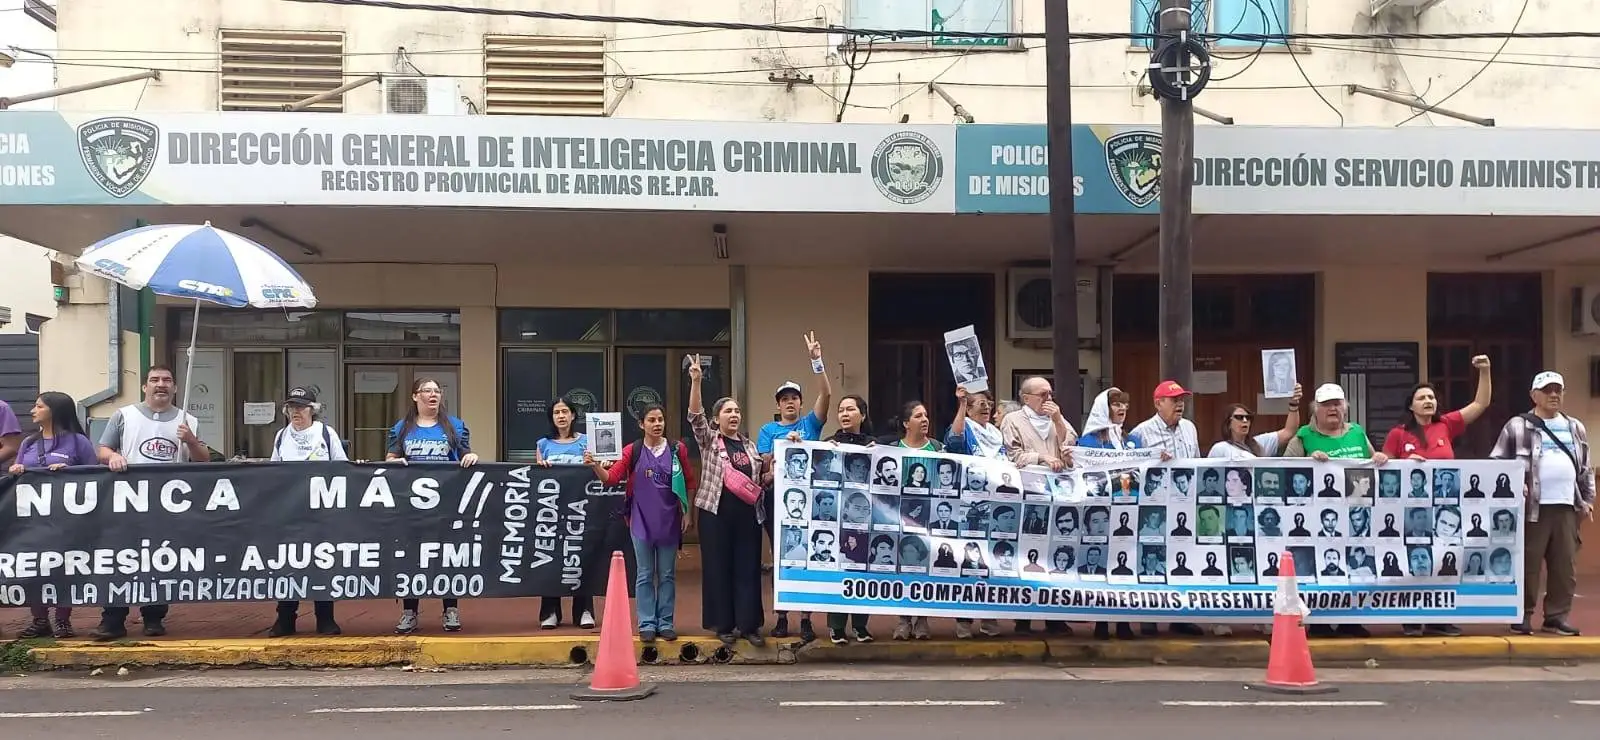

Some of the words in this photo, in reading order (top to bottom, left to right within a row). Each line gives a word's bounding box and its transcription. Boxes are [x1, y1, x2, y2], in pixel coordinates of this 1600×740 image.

[83, 122, 109, 136] POLICIA
[123, 122, 154, 136] MISIONES
[1109, 136, 1133, 149] POLICIA
[1145, 136, 1161, 144] MISIO
[168, 128, 333, 165] DIRECCIÓN
[342, 134, 470, 167] GENERAL
[478, 136, 514, 167] DE
[522, 137, 716, 171] INTELIGENCIA
[723, 141, 862, 173] CRIMINAL
[991, 145, 1048, 166] POLICI
[0, 165, 56, 186] ONES
[321, 171, 419, 192] REGISTRO
[425, 172, 541, 194] PROVINCIAL
[546, 173, 570, 194] DE
[573, 174, 643, 196] ARMAS
[648, 175, 719, 197] RE.P.AR.
[969, 175, 991, 195] DE
[995, 175, 1084, 196] MISIOS
[1192, 152, 1327, 187] DIRECCIÓN
[1334, 157, 1454, 188] SERVICIO
[1460, 159, 1600, 188] ADMINISTR
[15, 478, 241, 517] NUNCA
[499, 465, 531, 583] MEMORIA
[530, 478, 560, 568] VERDAD
[240, 542, 381, 571] AJUSTE
[419, 534, 482, 568] FMI
[559, 499, 588, 590] JUSTICIA
[42, 583, 58, 605] A
[71, 583, 98, 605] LA
[330, 575, 381, 598] SON
[395, 573, 484, 597] 30.000
[843, 579, 904, 599] 30000
[910, 581, 1032, 604] COMPAÑERXS
[1038, 588, 1182, 609] DESAPARECIDXS
[1188, 591, 1276, 609] PRESENTE
[1357, 592, 1368, 608] Y
[1371, 591, 1456, 609] SIEMPRE!!
